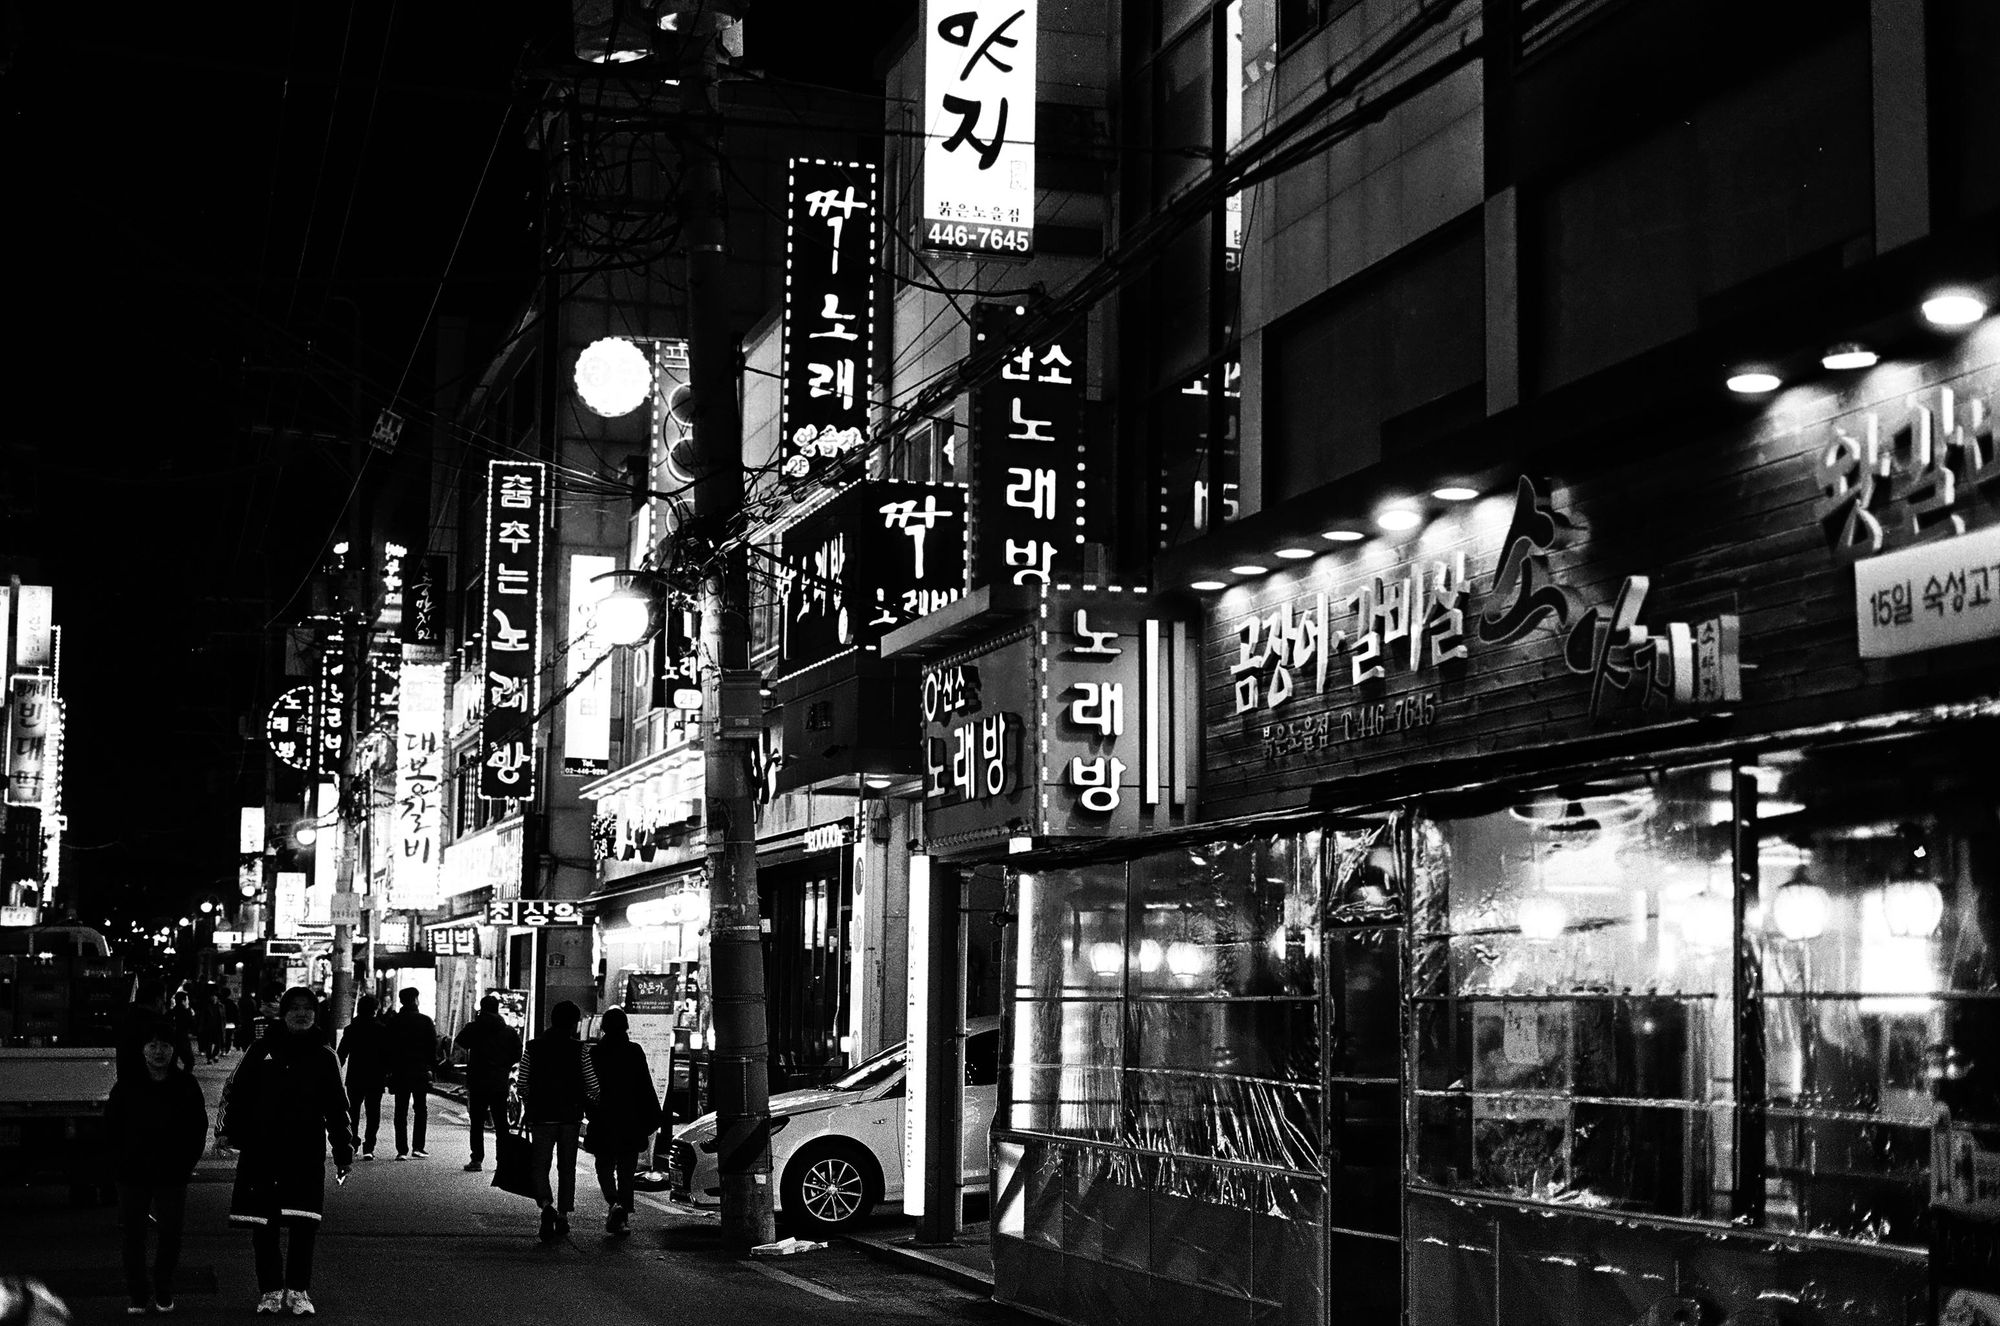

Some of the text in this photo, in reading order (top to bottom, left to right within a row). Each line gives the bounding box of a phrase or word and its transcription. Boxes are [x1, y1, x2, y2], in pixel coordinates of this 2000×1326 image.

[927, 223, 1030, 252] 446-7645
[1004, 397, 1058, 586] 노래방
[879, 495, 953, 580] 짝
[1869, 578, 1914, 628] 15일
[1070, 608, 1127, 811] 노래방
[926, 711, 1006, 800] 노래방
